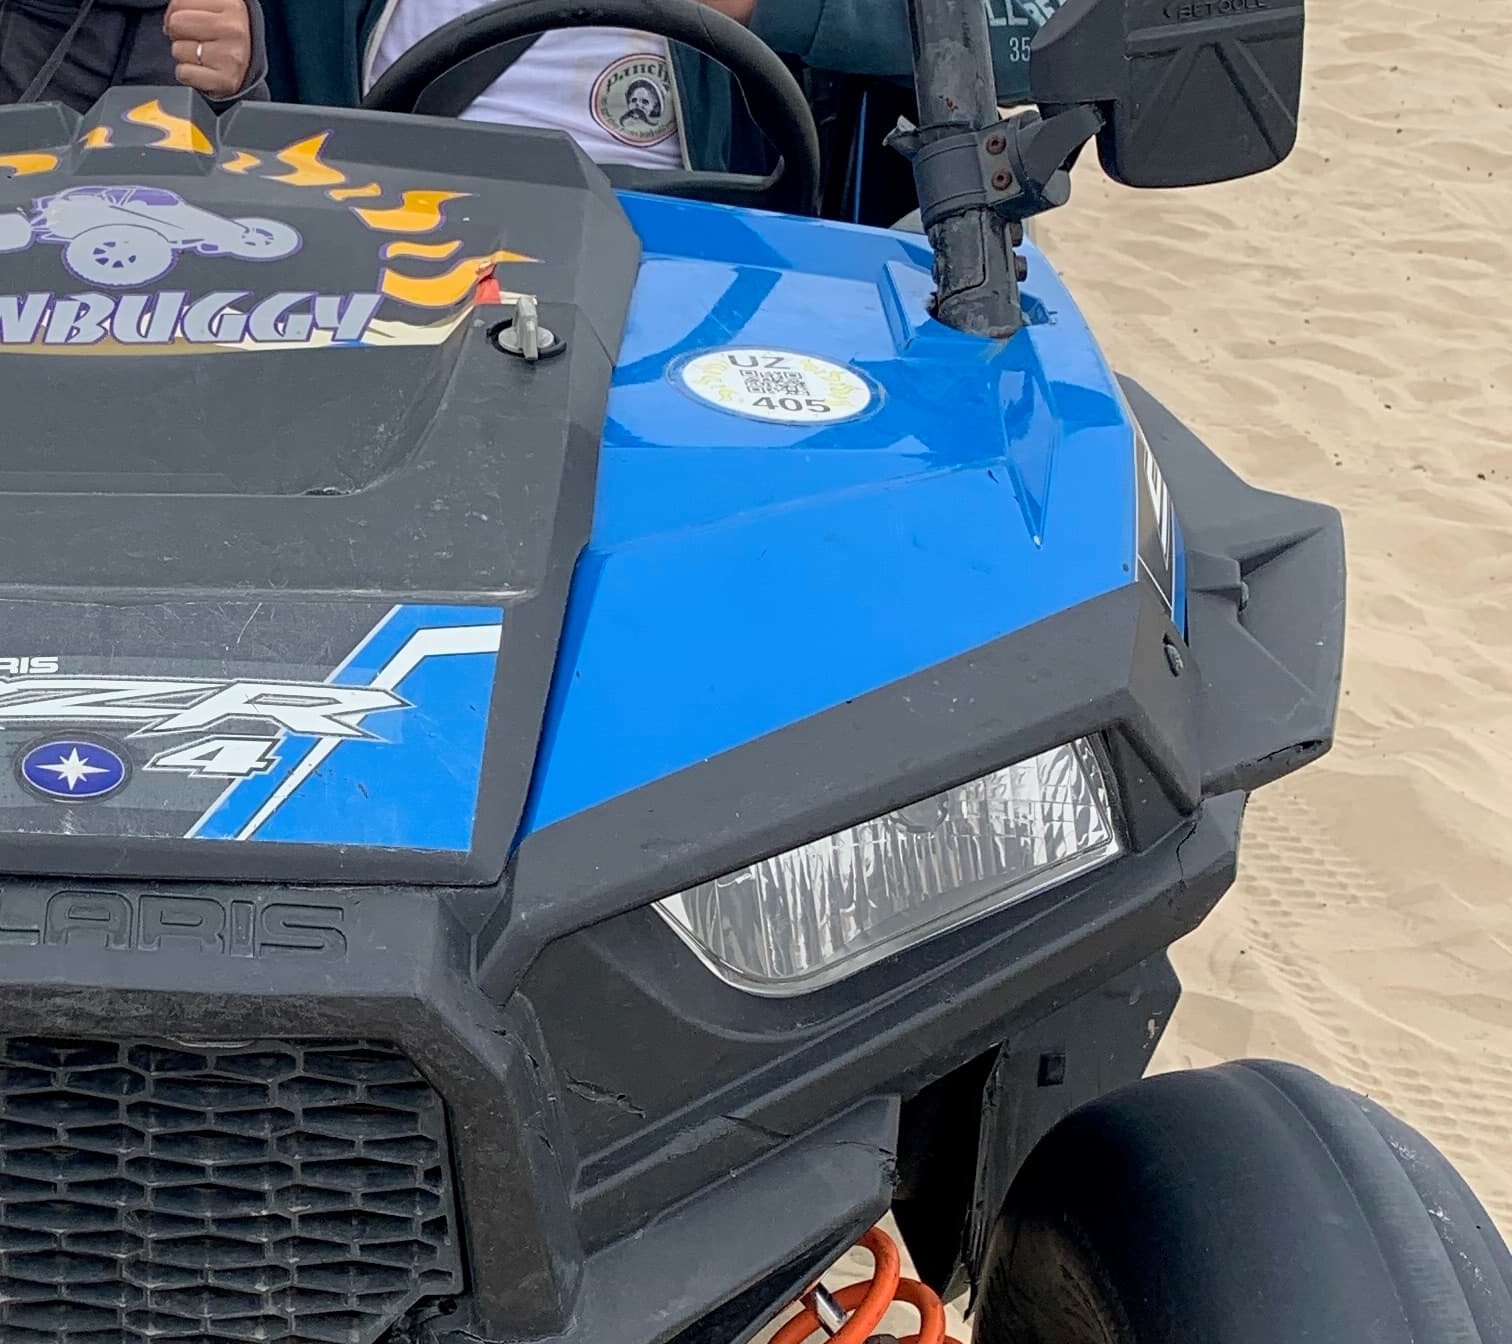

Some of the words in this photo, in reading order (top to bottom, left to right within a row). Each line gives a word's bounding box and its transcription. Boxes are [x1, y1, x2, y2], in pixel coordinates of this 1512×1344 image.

[727, 355, 791, 369] UZ
[752, 396, 831, 413] 405
[142, 734, 287, 779] 4
